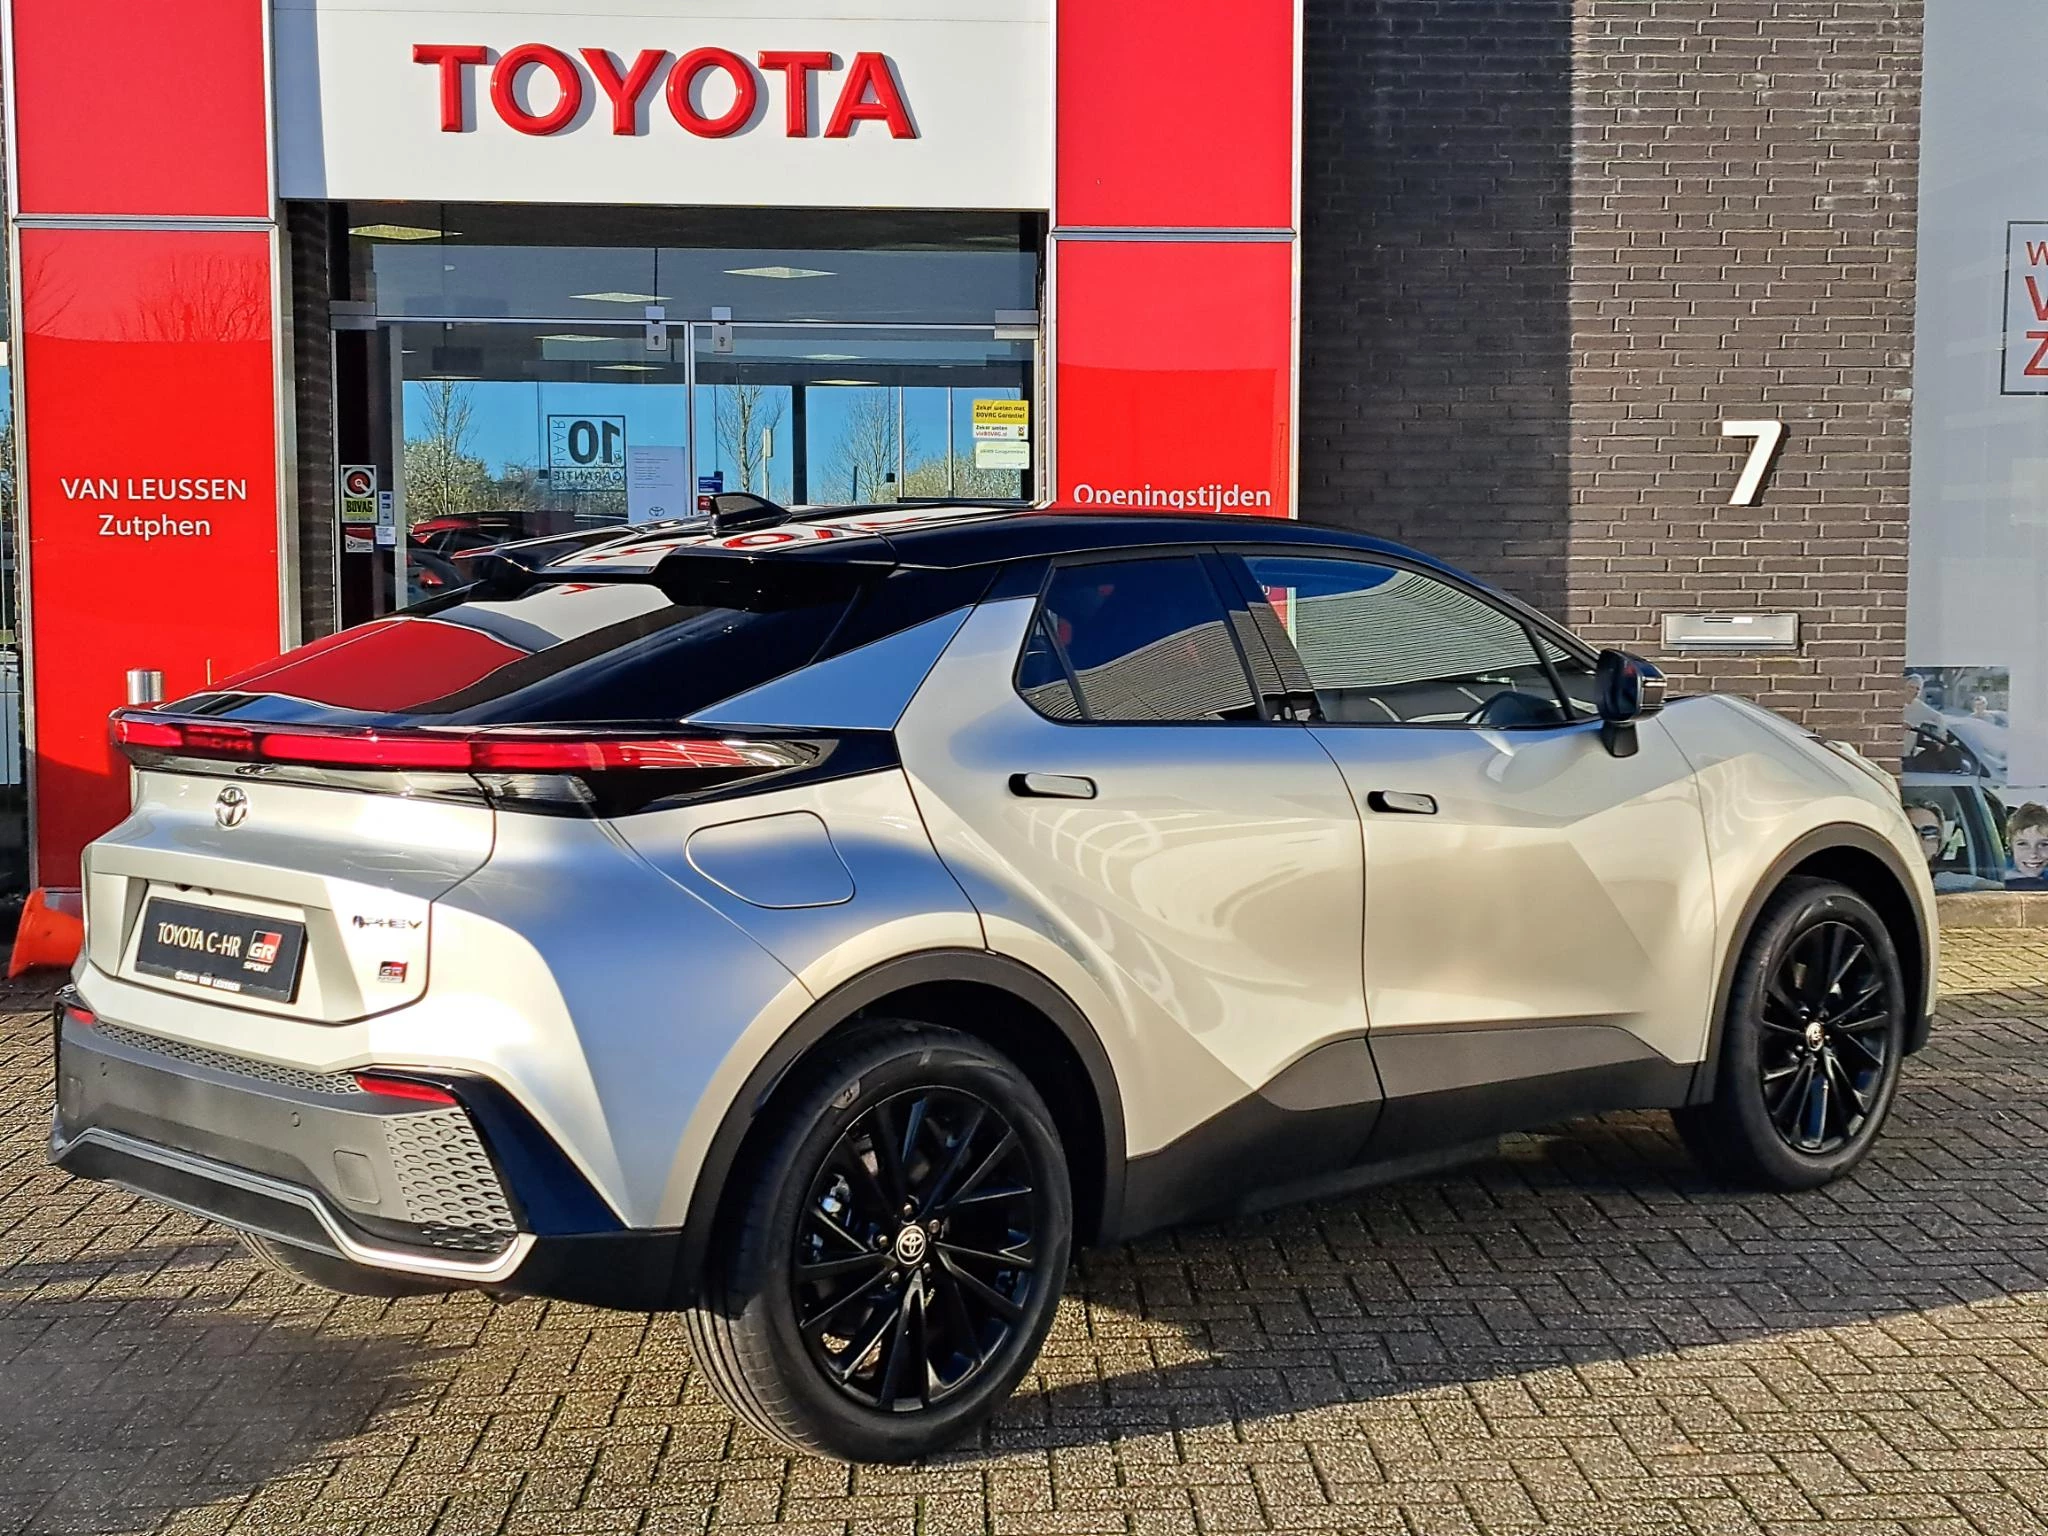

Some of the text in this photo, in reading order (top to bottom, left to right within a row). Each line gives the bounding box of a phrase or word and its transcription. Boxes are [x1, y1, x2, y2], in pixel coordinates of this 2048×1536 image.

[412, 43, 918, 140] TOYOTA
[1722, 420, 1782, 505] 7
[60, 478, 247, 501] VAN LEUSSEN
[1073, 483, 1271, 513] Openingstijden
[98, 513, 211, 542] Zutphen
[158, 921, 242, 958] TOYOTA C-HR
[249, 942, 275, 960] GR
[243, 962, 272, 973] SPORT
